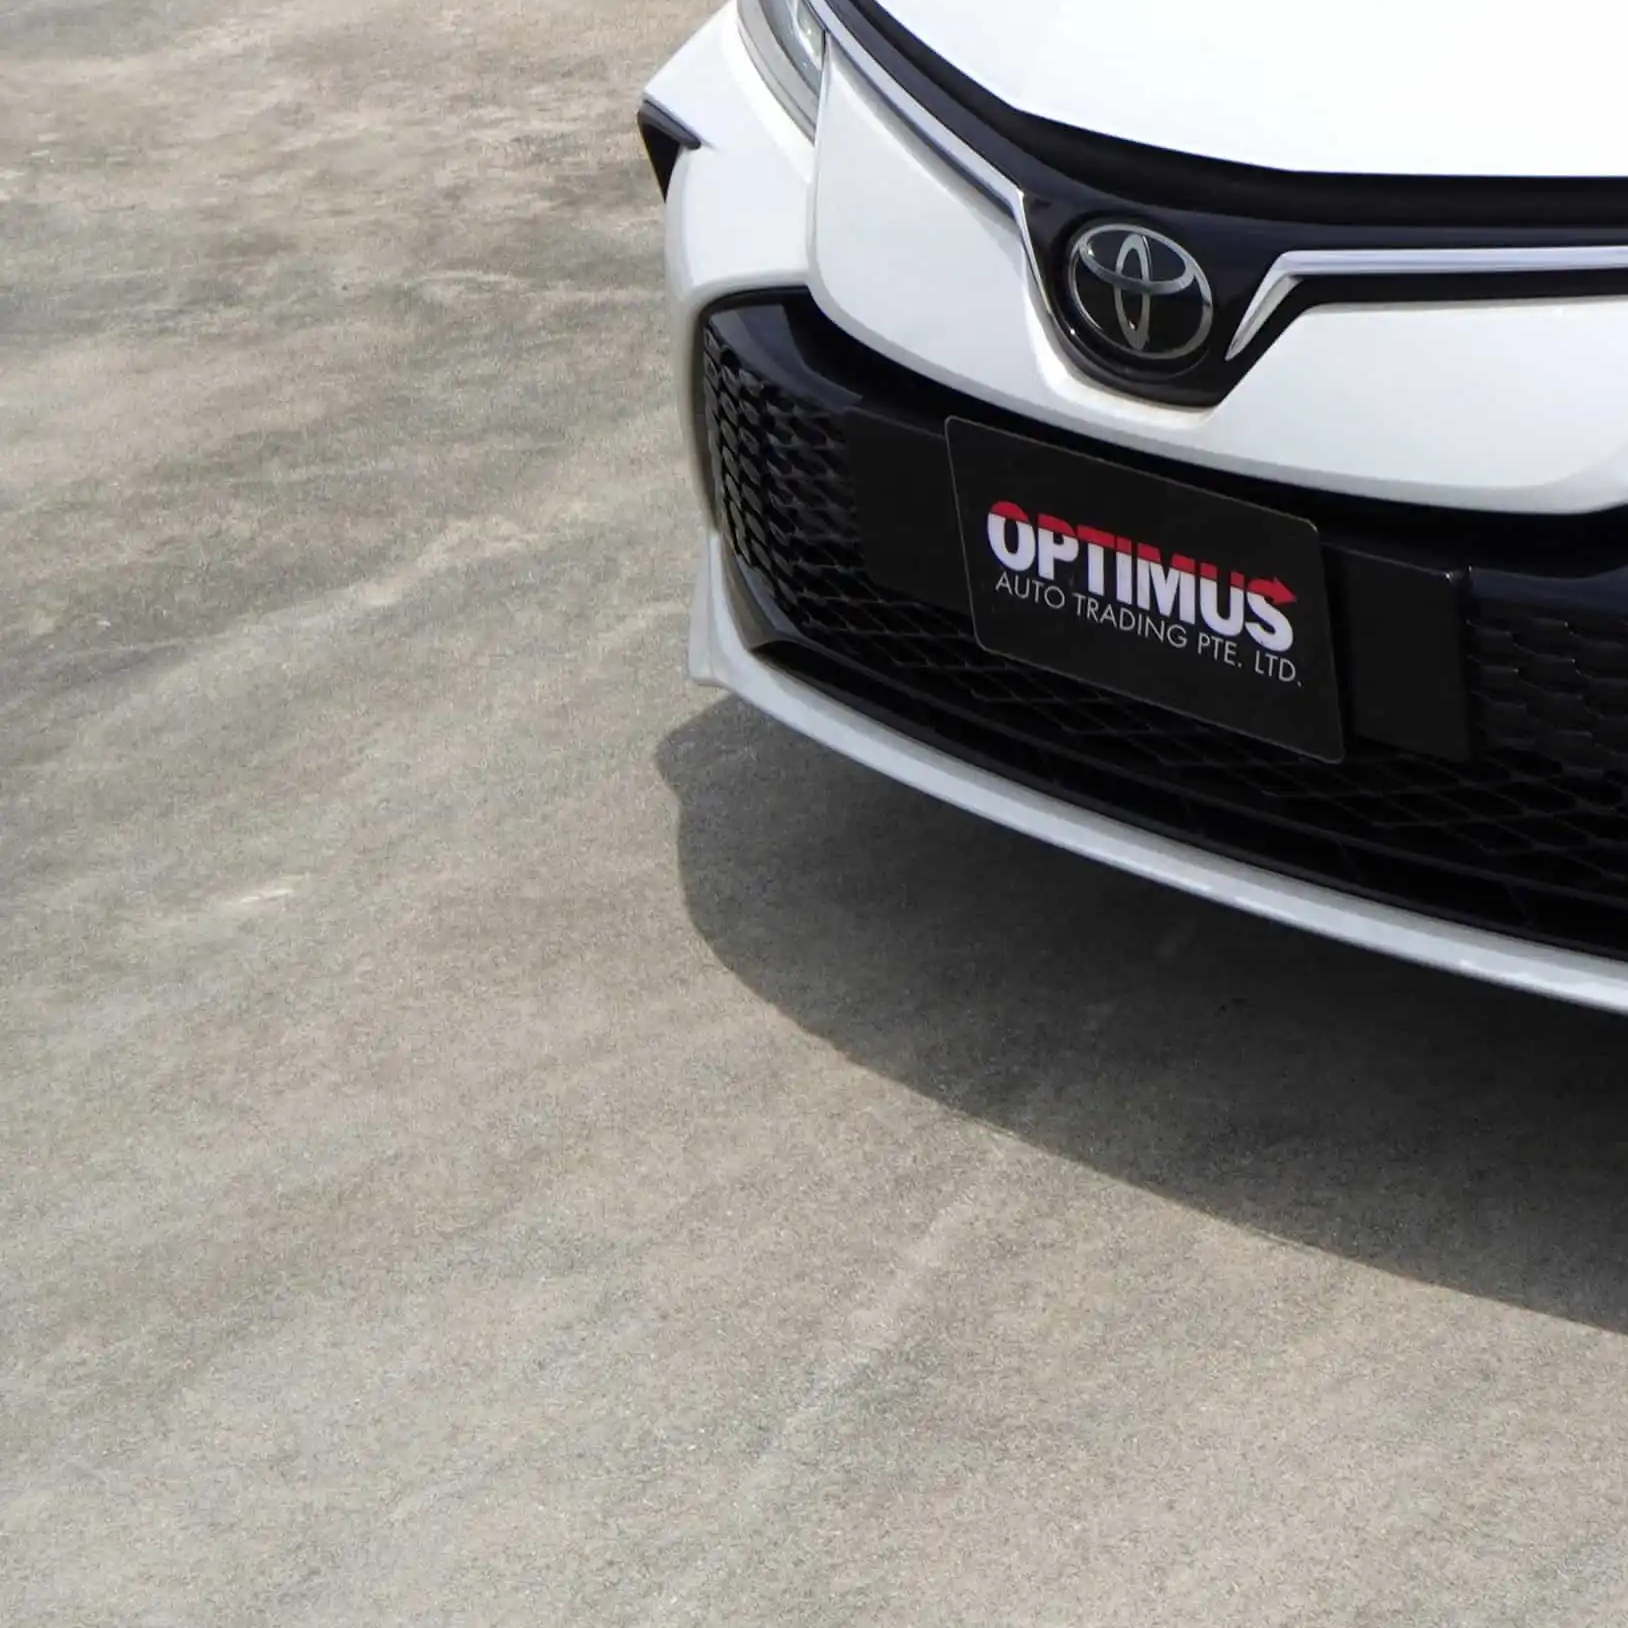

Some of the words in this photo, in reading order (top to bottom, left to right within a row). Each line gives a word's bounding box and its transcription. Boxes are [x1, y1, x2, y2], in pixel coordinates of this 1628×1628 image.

[987, 501, 1297, 652] OPTIMUS
[995, 571, 1066, 609] AUTO
[1072, 592, 1188, 648] TRADING
[1197, 633, 1242, 668] PTE.
[1254, 650, 1303, 687] LTD.
